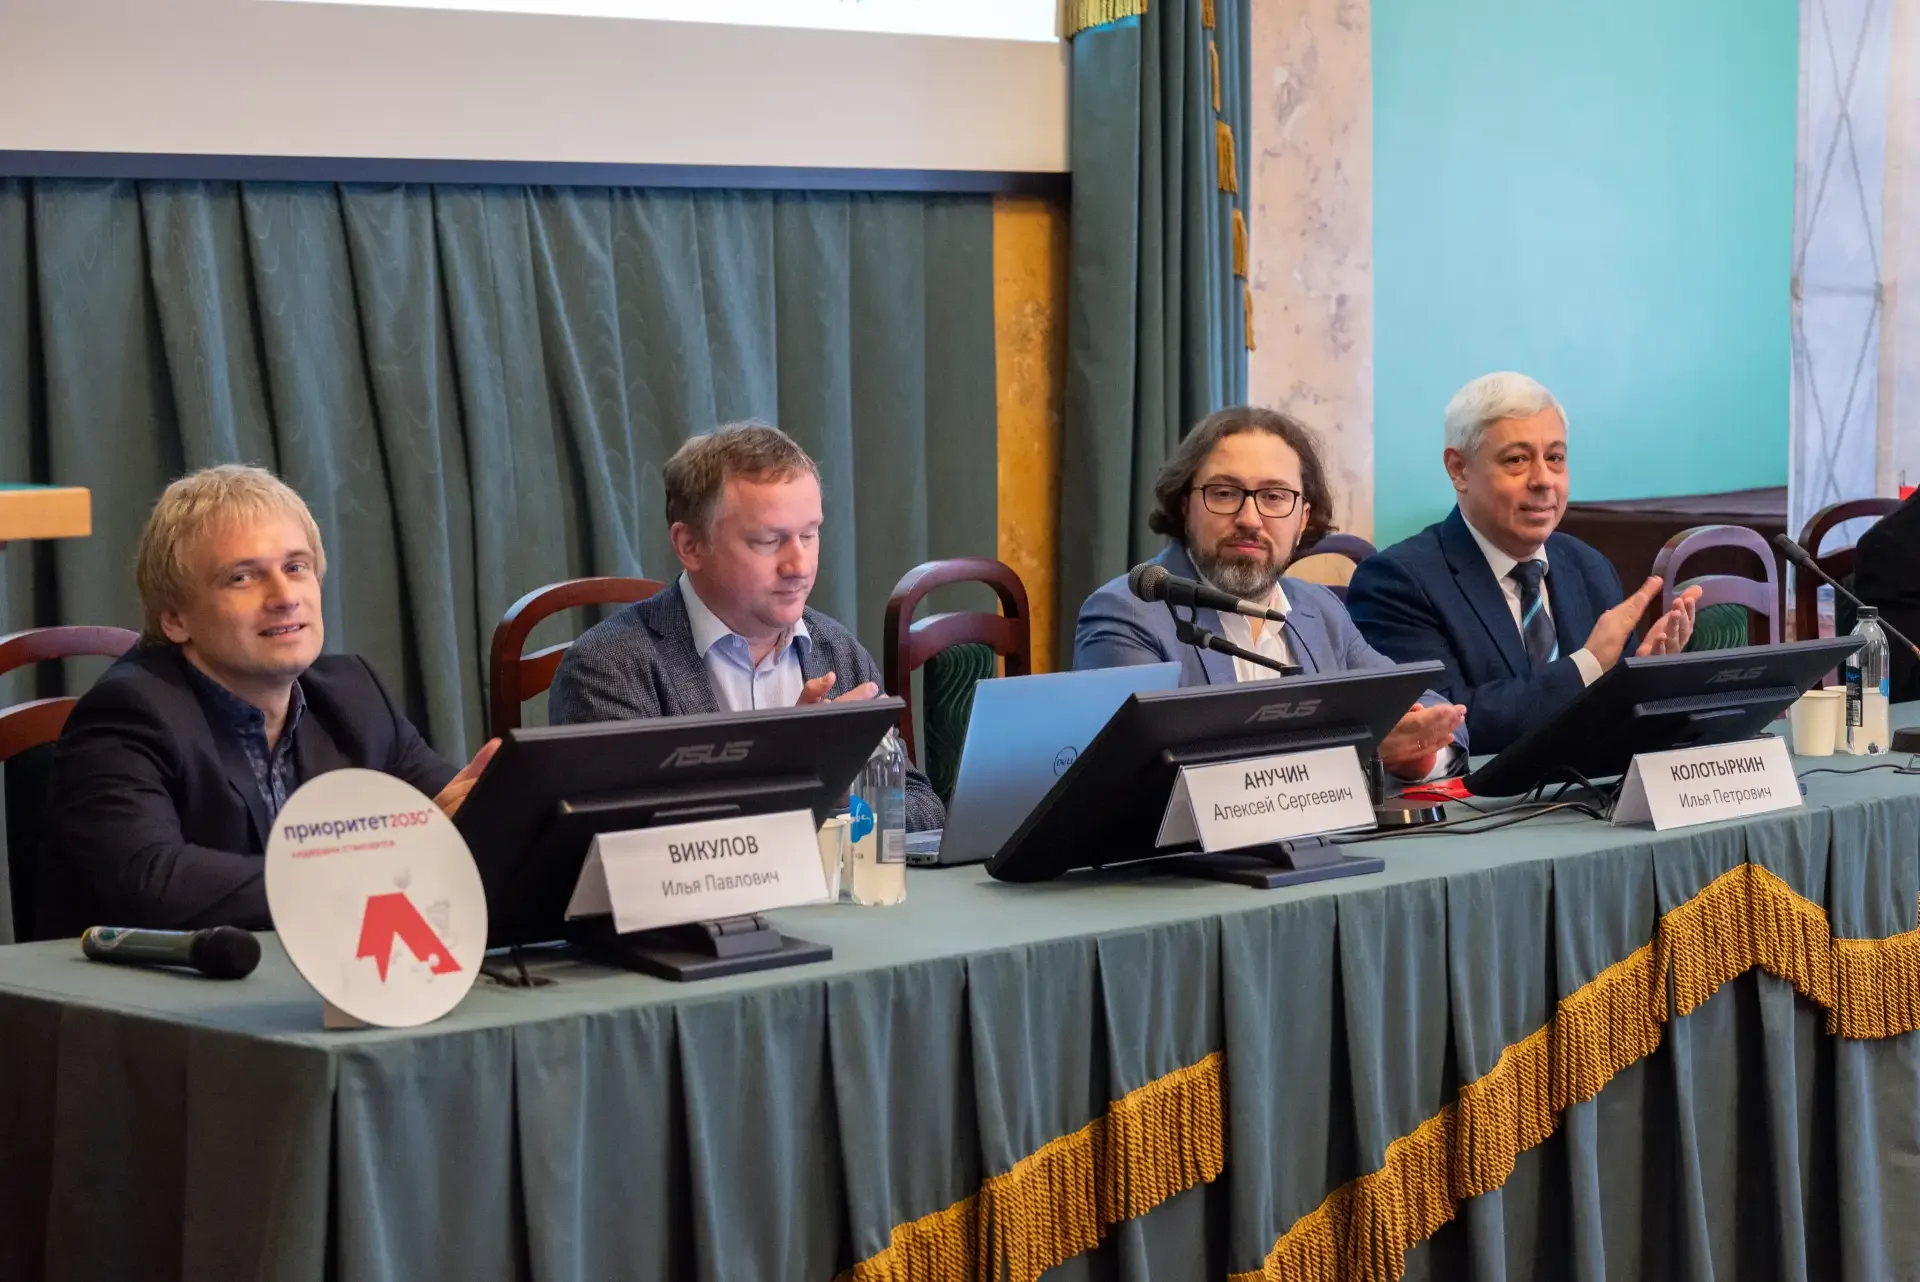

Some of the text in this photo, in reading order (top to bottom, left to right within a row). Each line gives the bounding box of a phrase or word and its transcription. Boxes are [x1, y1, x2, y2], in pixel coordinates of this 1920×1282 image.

[1706, 667, 1766, 684] ASUS
[1246, 700, 1322, 723] ASUS
[660, 741, 753, 768] ASUS
[1244, 763, 1310, 790] АНУЧИН
[1670, 756, 1766, 782] КОЛОТЫРКИН
[1213, 786, 1353, 822] Алексей Сергеевич
[1678, 786, 1772, 809] Илья Петрович
[668, 835, 759, 864] ВИКУЛОВ
[661, 869, 780, 898] Илья Павлович
